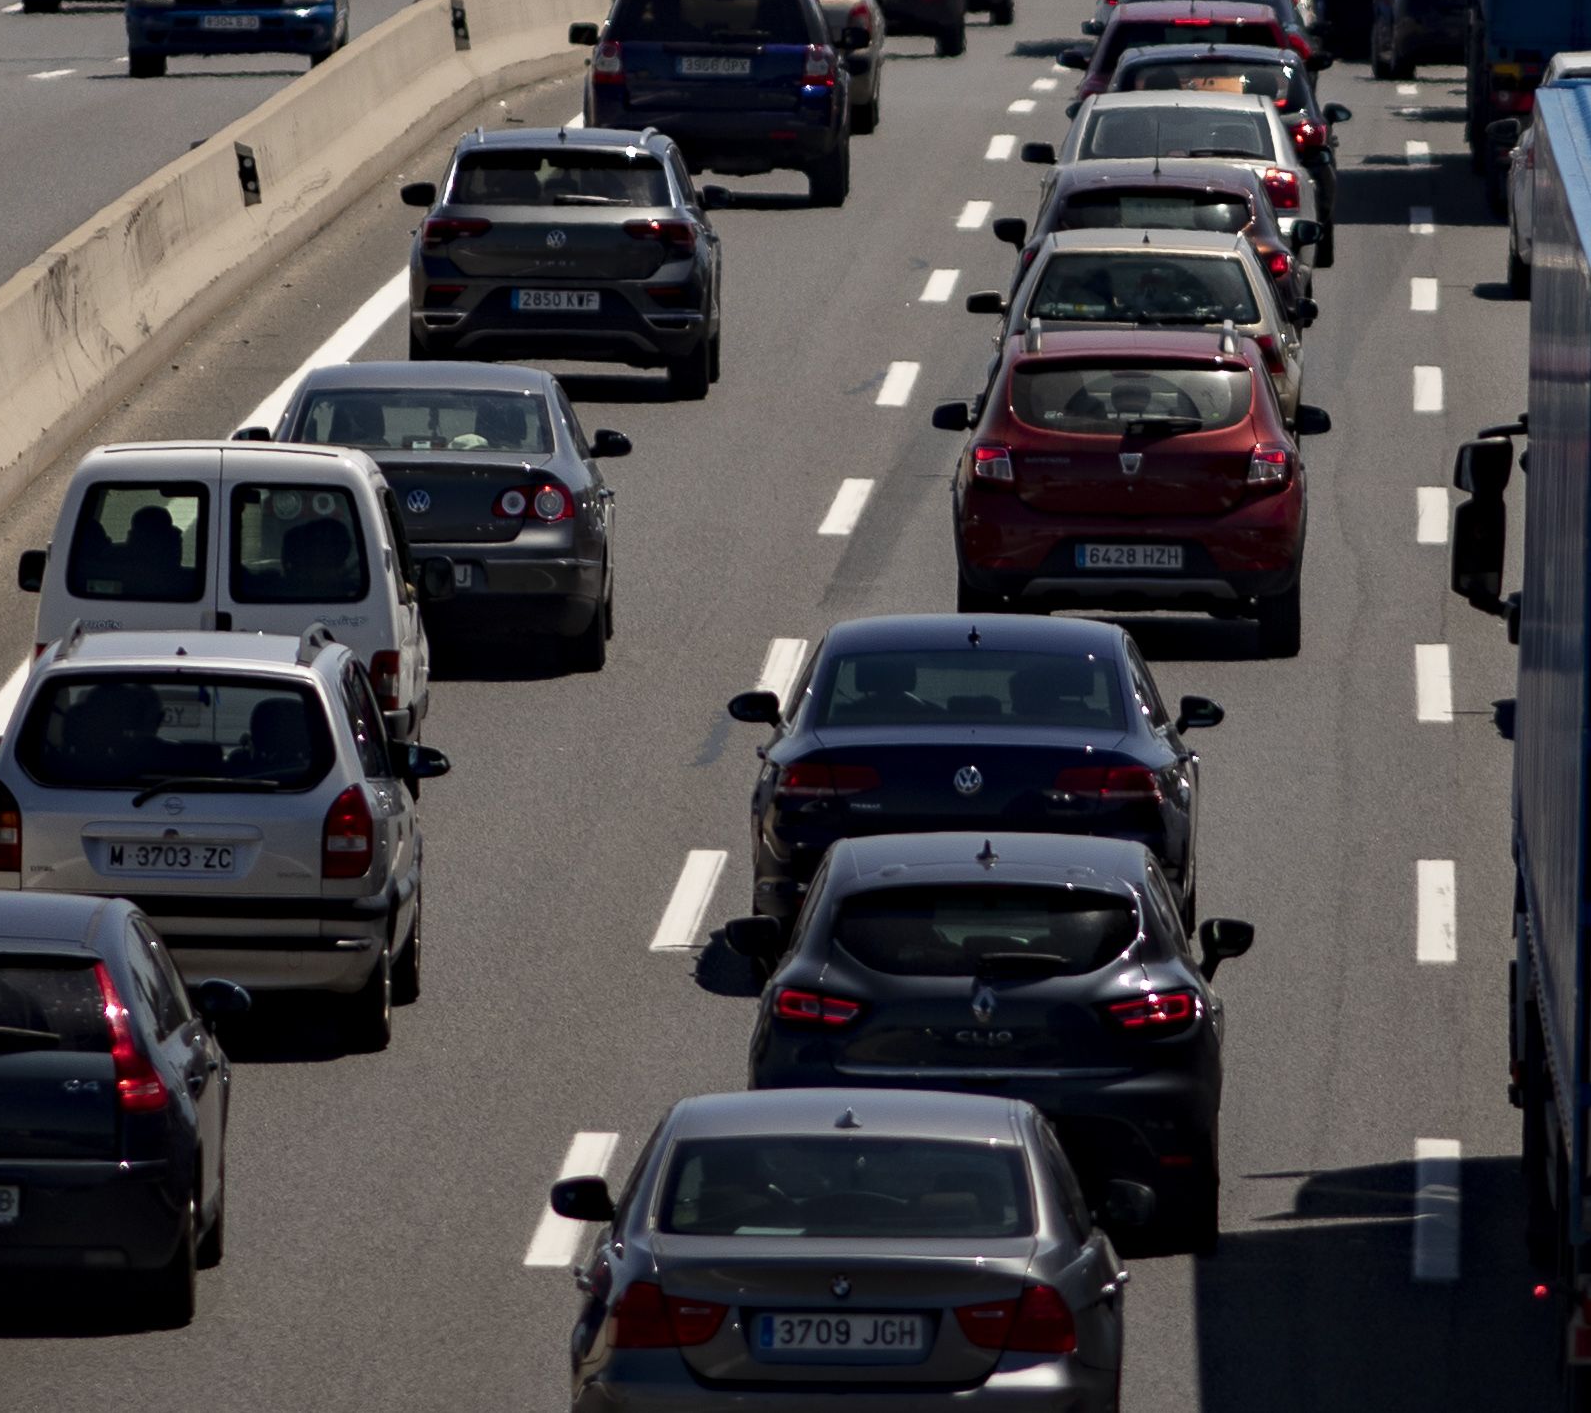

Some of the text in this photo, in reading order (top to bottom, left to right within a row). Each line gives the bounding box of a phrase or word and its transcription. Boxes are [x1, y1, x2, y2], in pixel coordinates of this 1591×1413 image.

[522, 292, 562, 307] 2850
[1089, 547, 1179, 565] 6428 HZH
[779, 1318, 916, 1346] 3709 JGH
